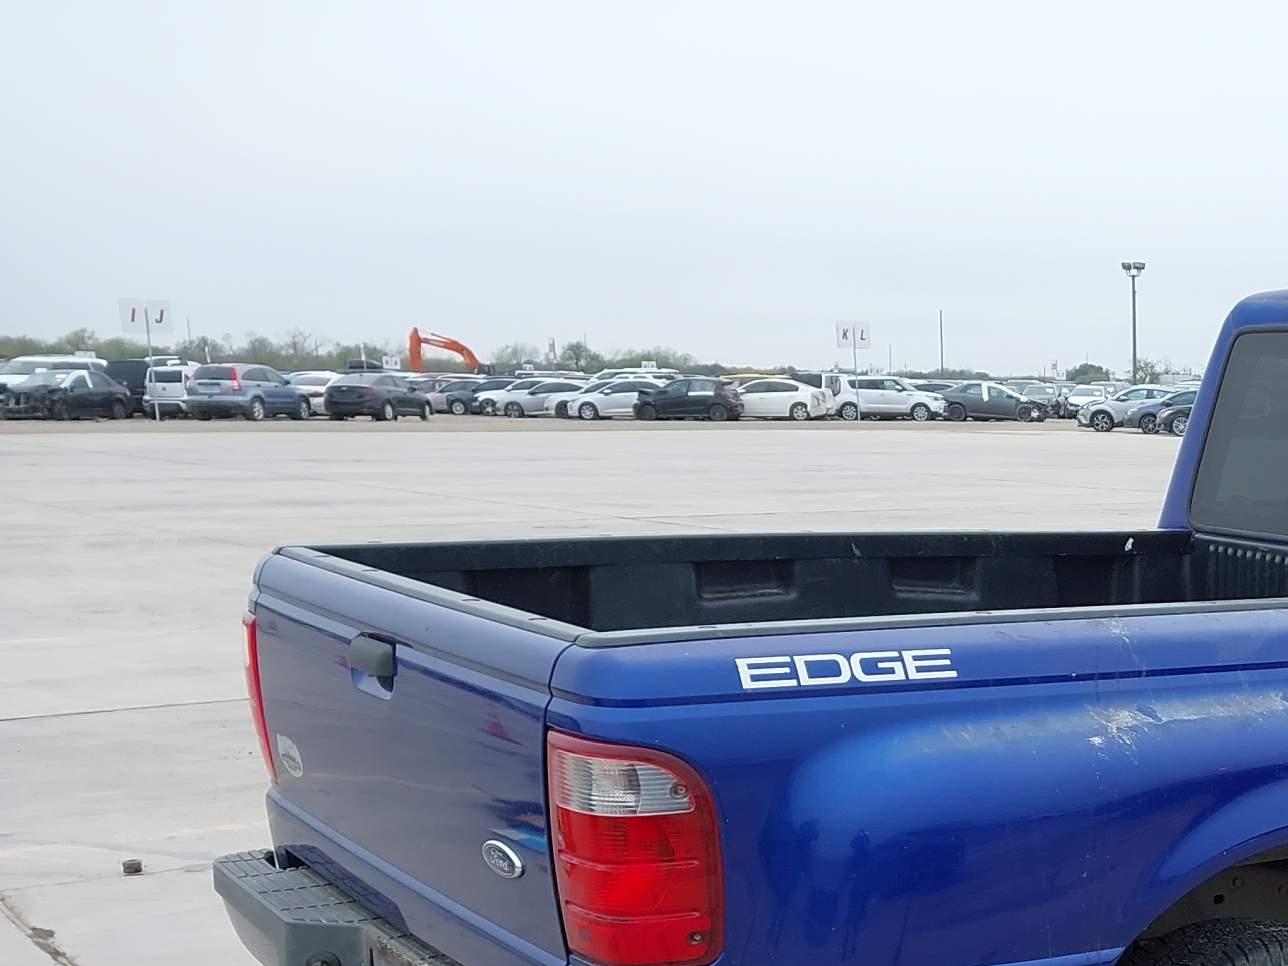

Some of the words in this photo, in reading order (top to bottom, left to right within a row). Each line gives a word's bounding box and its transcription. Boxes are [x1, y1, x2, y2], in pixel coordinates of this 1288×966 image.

[154, 308, 164, 324] J
[842, 328, 849, 340] K
[860, 328, 866, 341] L
[735, 649, 958, 689] EDGE
